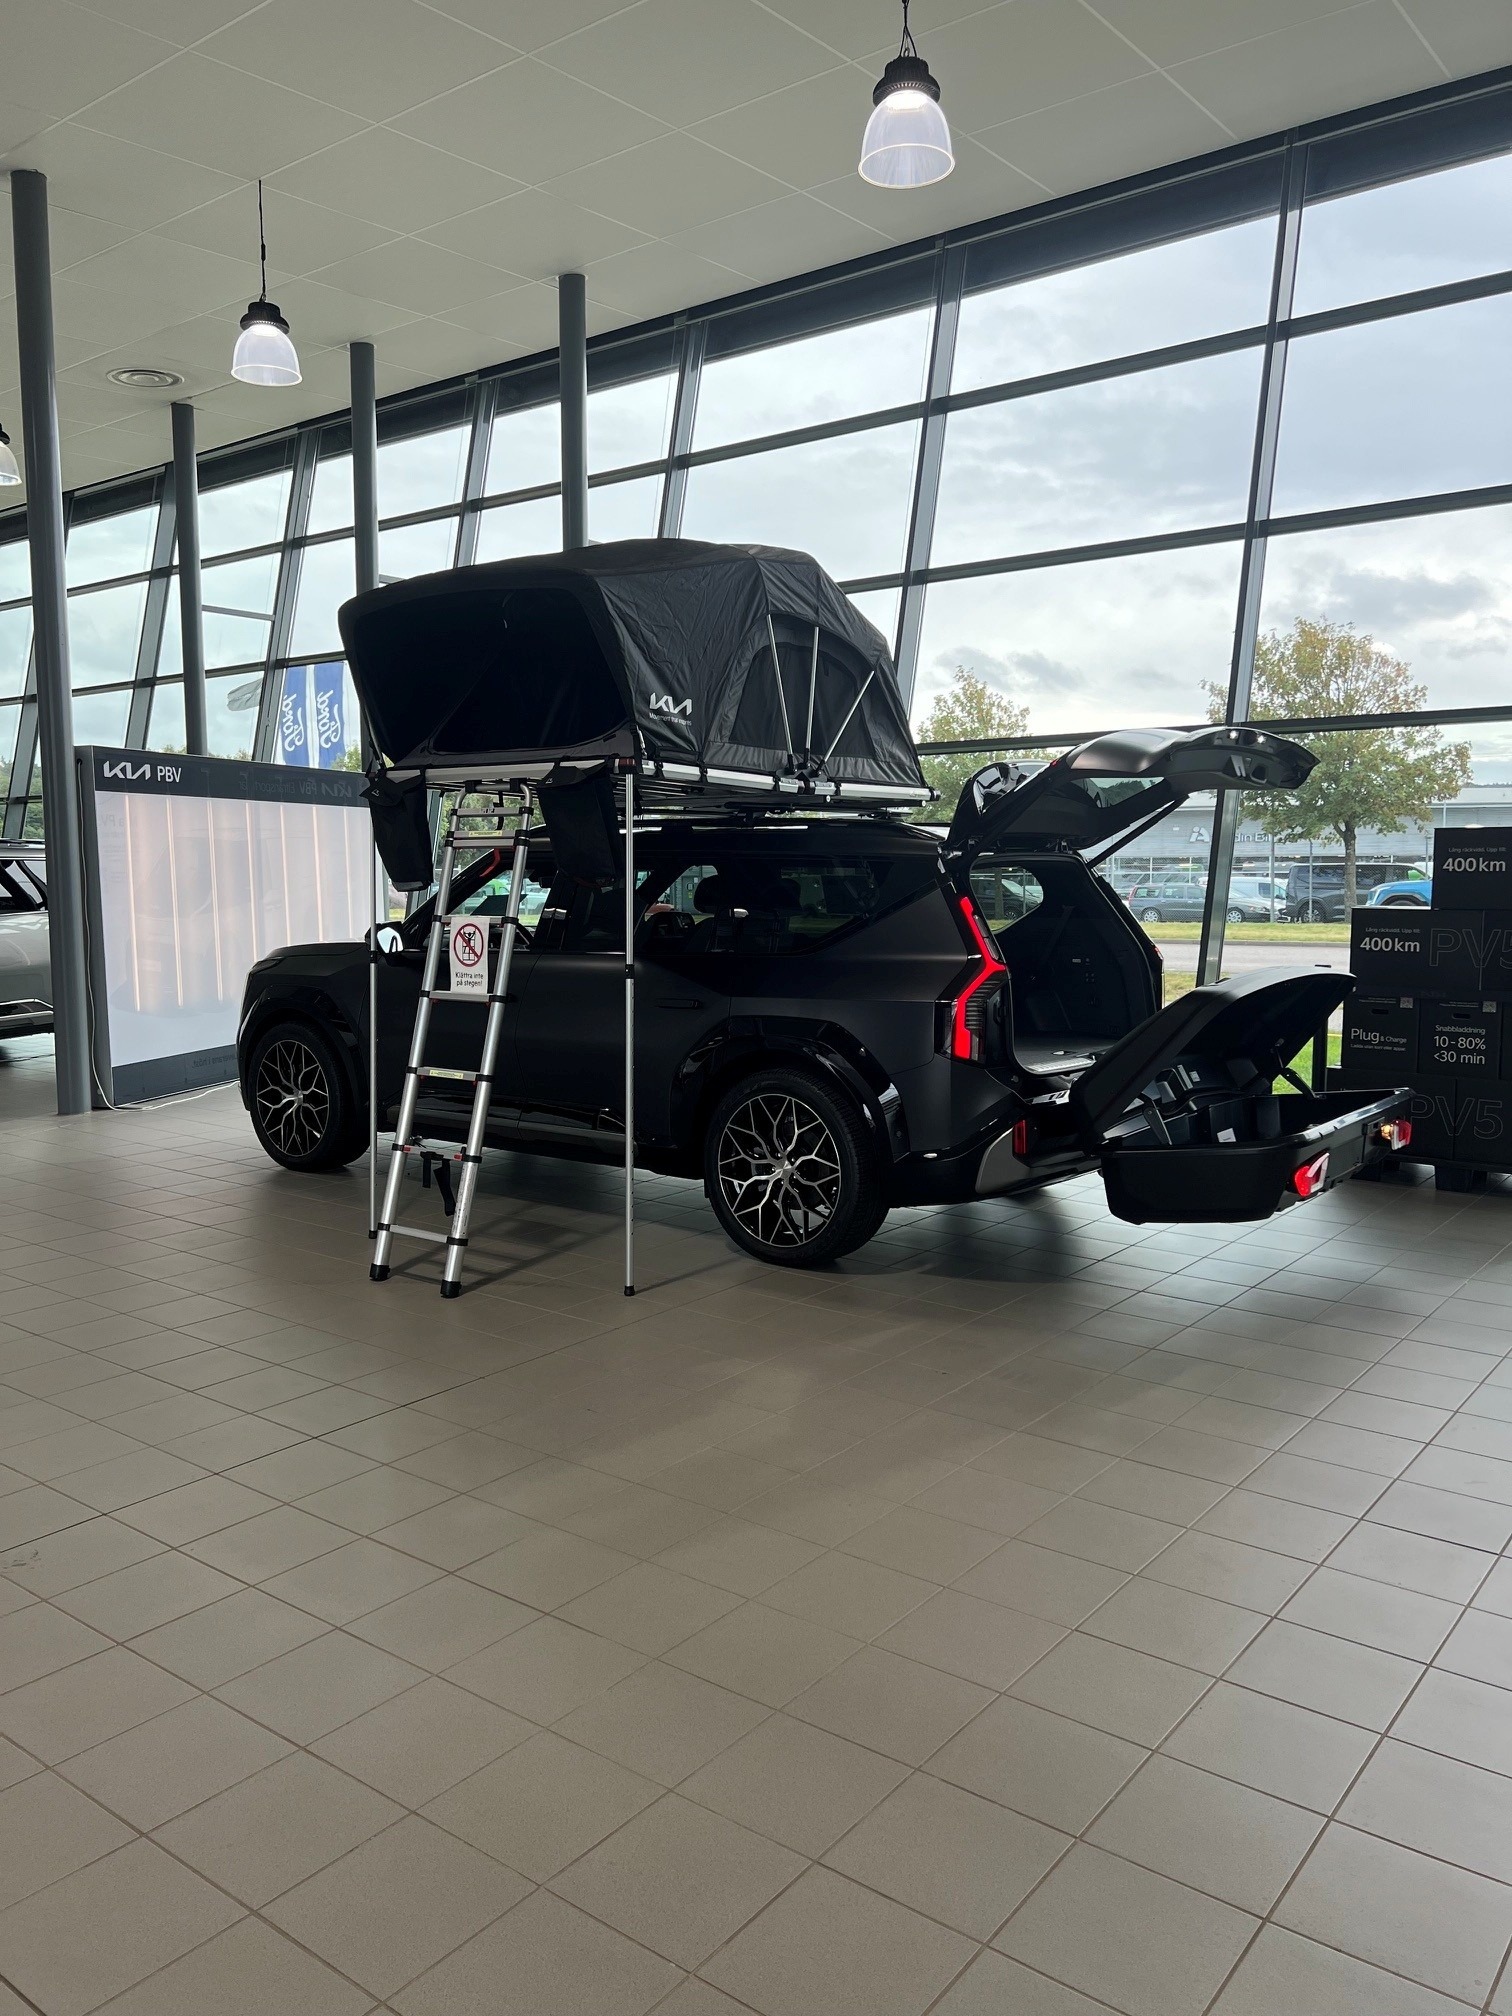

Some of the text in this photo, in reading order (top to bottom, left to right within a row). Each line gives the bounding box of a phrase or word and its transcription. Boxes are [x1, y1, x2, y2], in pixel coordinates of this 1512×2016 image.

[649, 692, 692, 715] KIA
[103, 760, 181, 783] KIA PBV
[1442, 857, 1506, 872] 400 km
[1360, 937, 1420, 952] 400 km
[455, 971, 473, 979] Klättra
[464, 979, 483, 987] stegen!
[1351, 1028, 1380, 1044] Plug
[1385, 1036, 1407, 1044] Charge
[1435, 1024, 1486, 1035] Snabbladdning
[1434, 1050, 1485, 1064] <30 min
